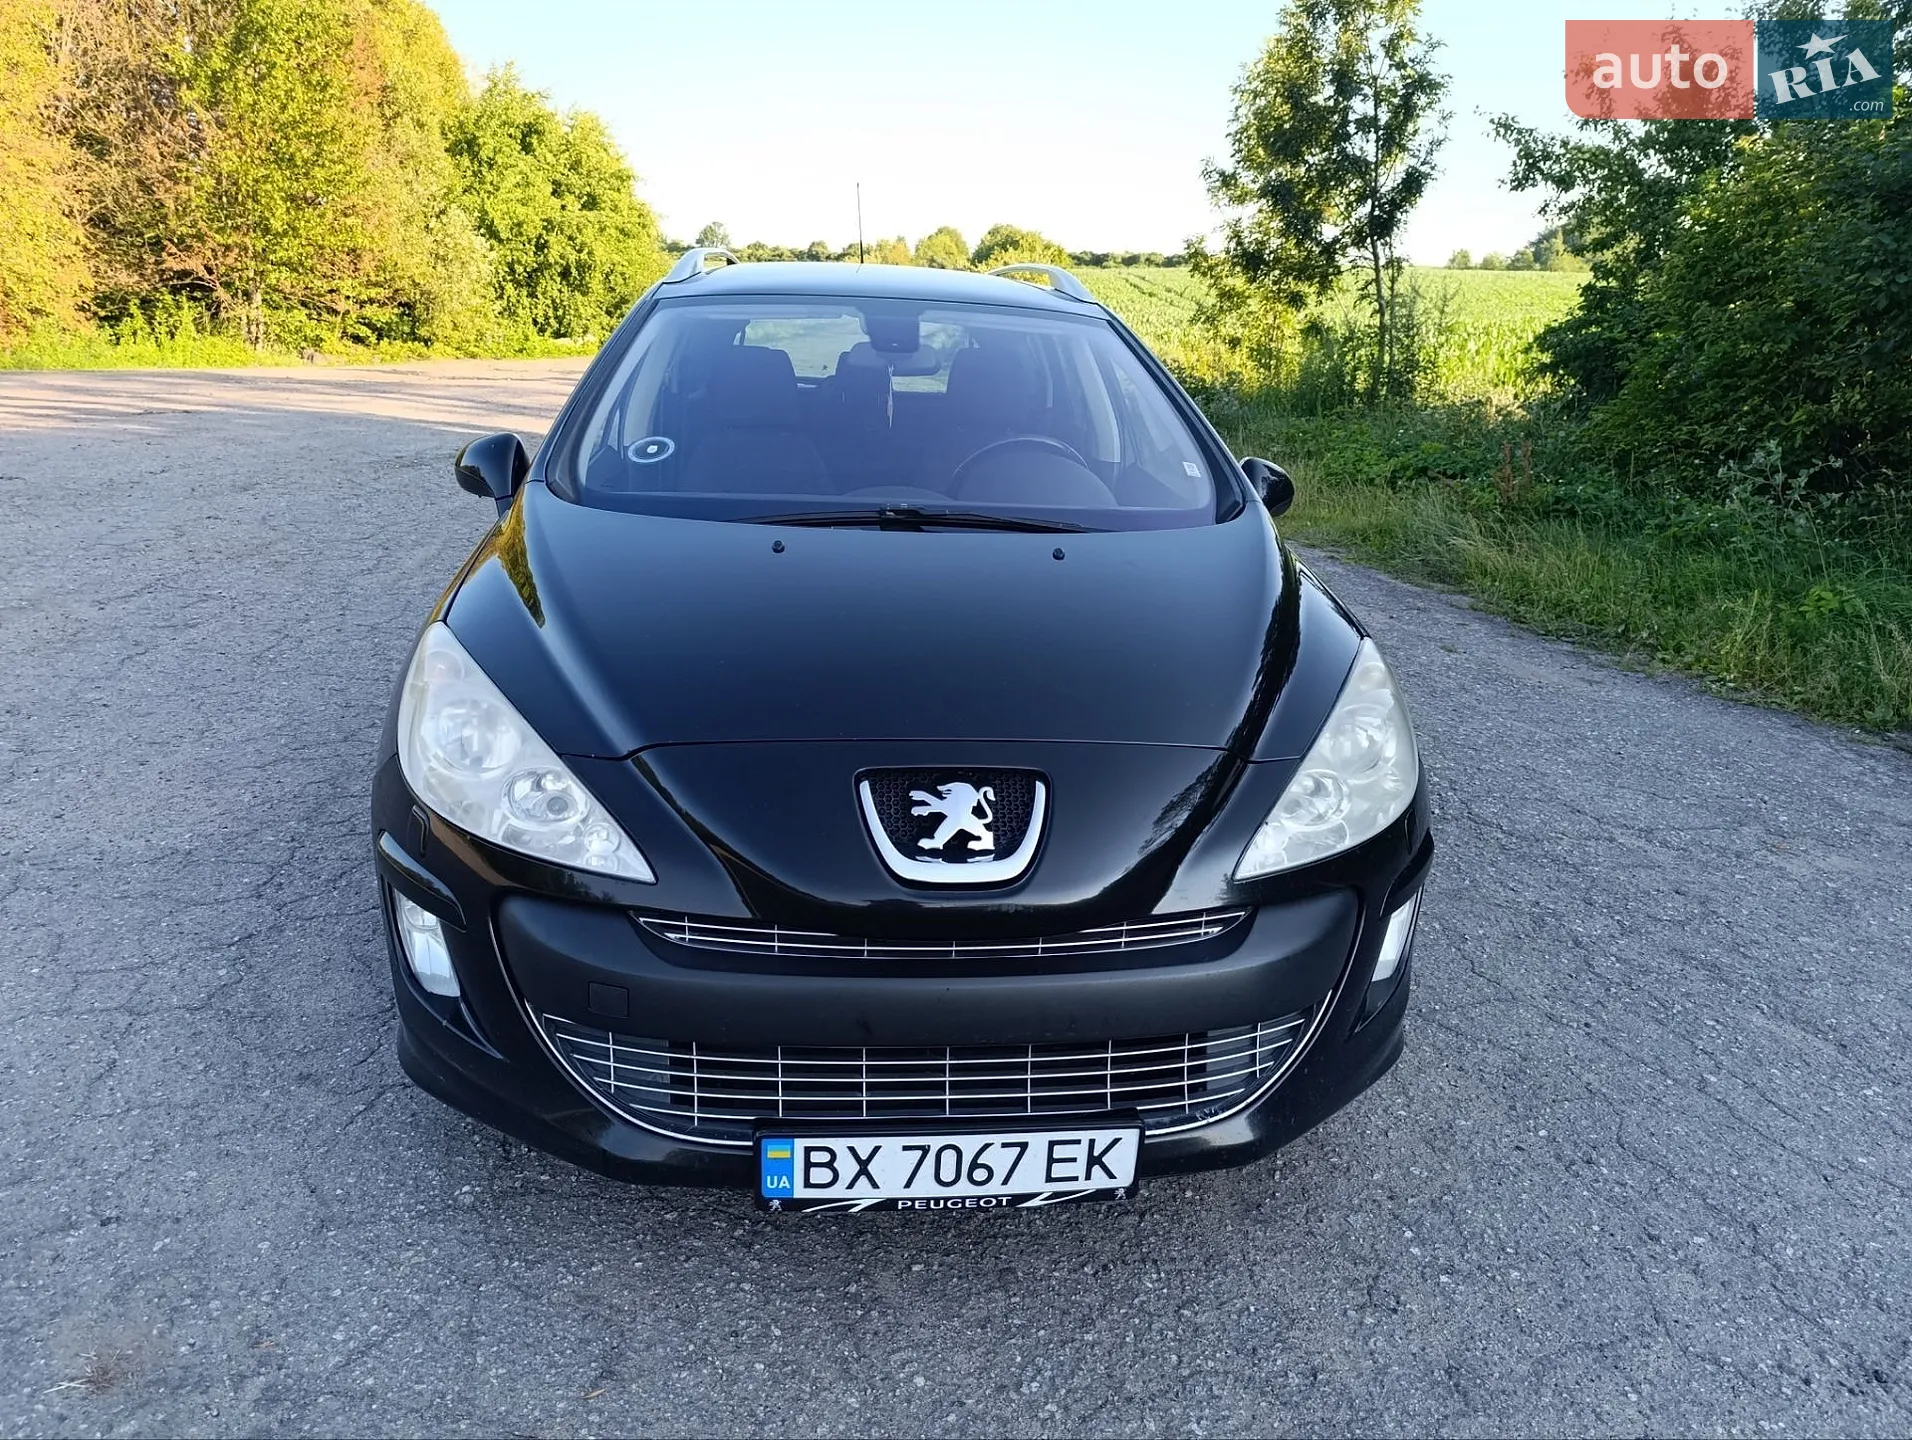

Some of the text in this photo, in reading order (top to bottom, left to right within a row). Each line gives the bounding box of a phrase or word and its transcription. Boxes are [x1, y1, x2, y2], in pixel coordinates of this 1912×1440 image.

[803, 1137, 1123, 1190] BX 7067 EK
[766, 1175, 791, 1189] UA
[897, 1196, 1012, 1210] PEUGEOT
